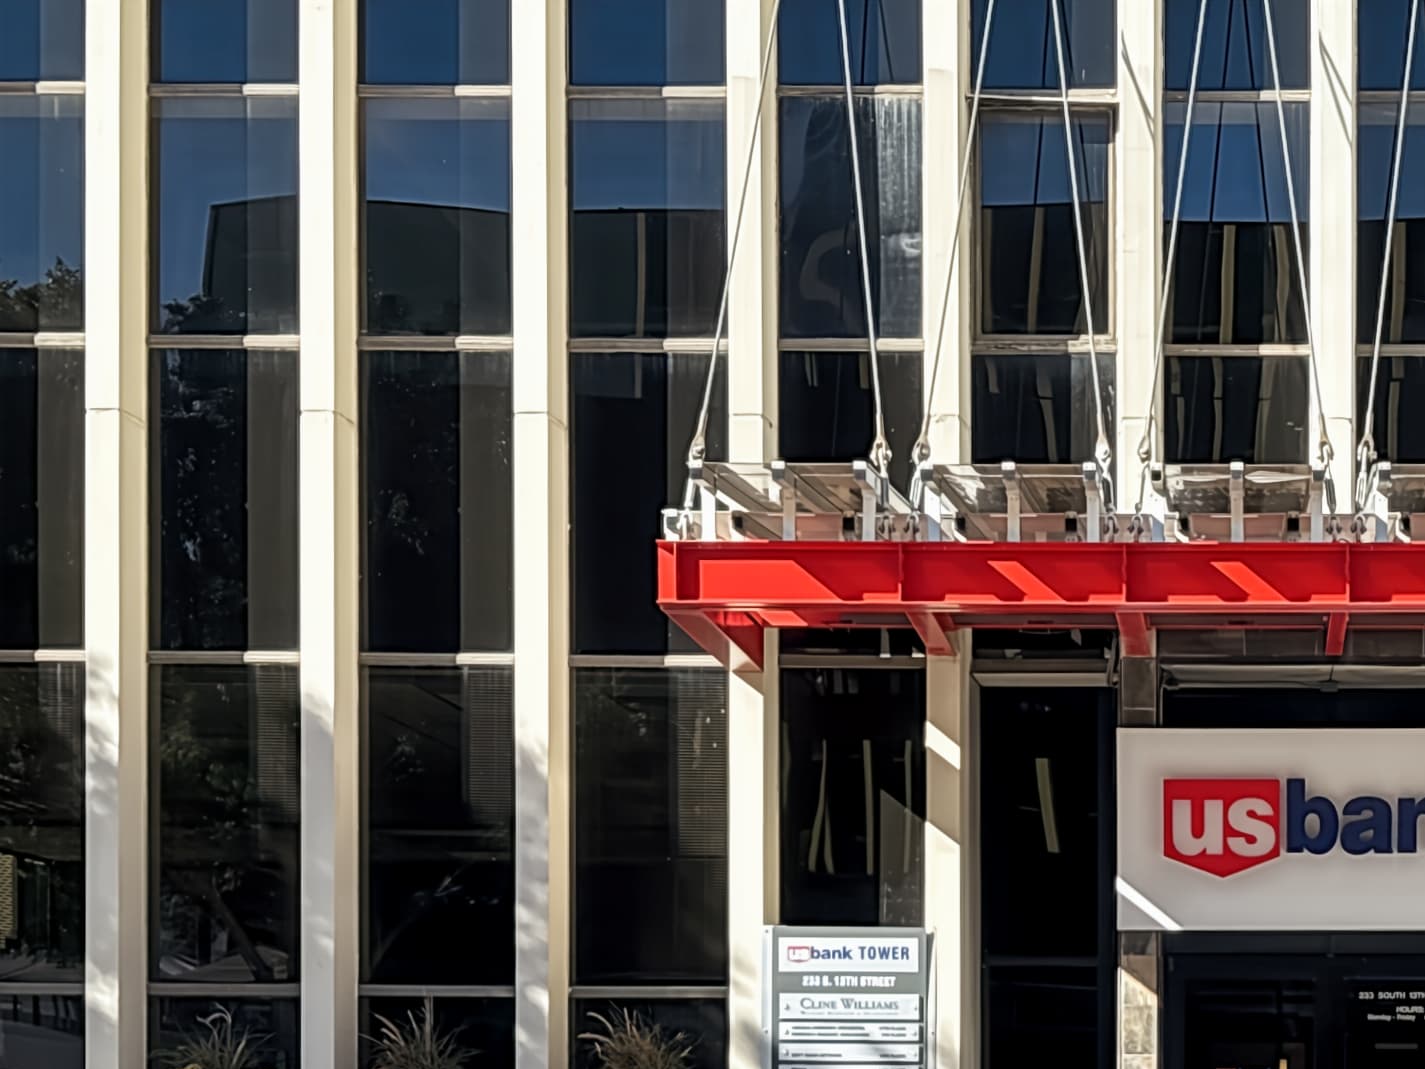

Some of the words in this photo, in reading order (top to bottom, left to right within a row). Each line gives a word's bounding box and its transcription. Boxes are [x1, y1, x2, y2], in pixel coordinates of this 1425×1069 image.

[789, 946, 853, 961] bank
[858, 946, 909, 960] TOWER
[860, 976, 896, 987] STREET
[1378, 991, 1406, 1000] SOUTH
[800, 997, 838, 1010] CLINE
[840, 997, 899, 1010] WILLIAMS
